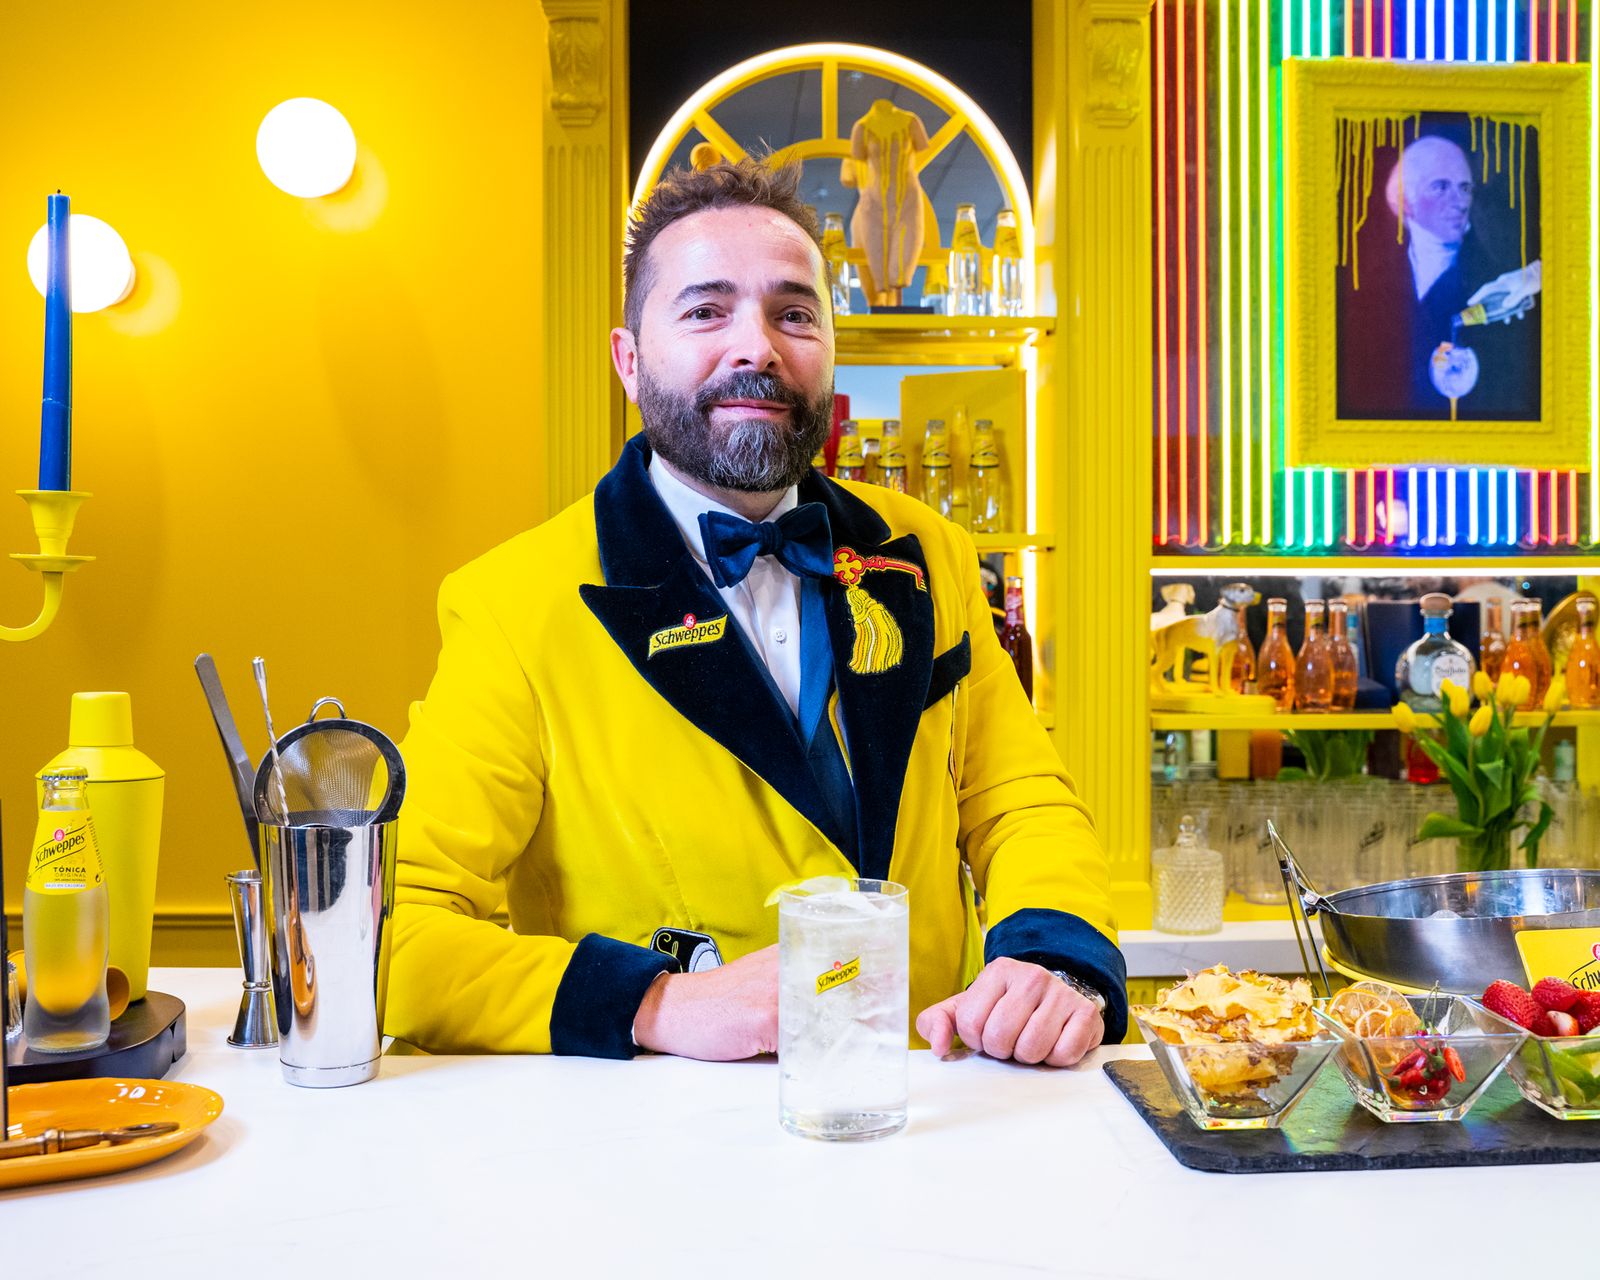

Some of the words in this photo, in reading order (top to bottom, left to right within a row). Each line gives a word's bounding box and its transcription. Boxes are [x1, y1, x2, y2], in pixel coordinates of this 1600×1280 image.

[653, 622, 721, 648] Schweppes
[35, 831, 86, 868] Schweppes
[53, 865, 86, 873] TÓNICA
[818, 966, 858, 991] Schweppes
